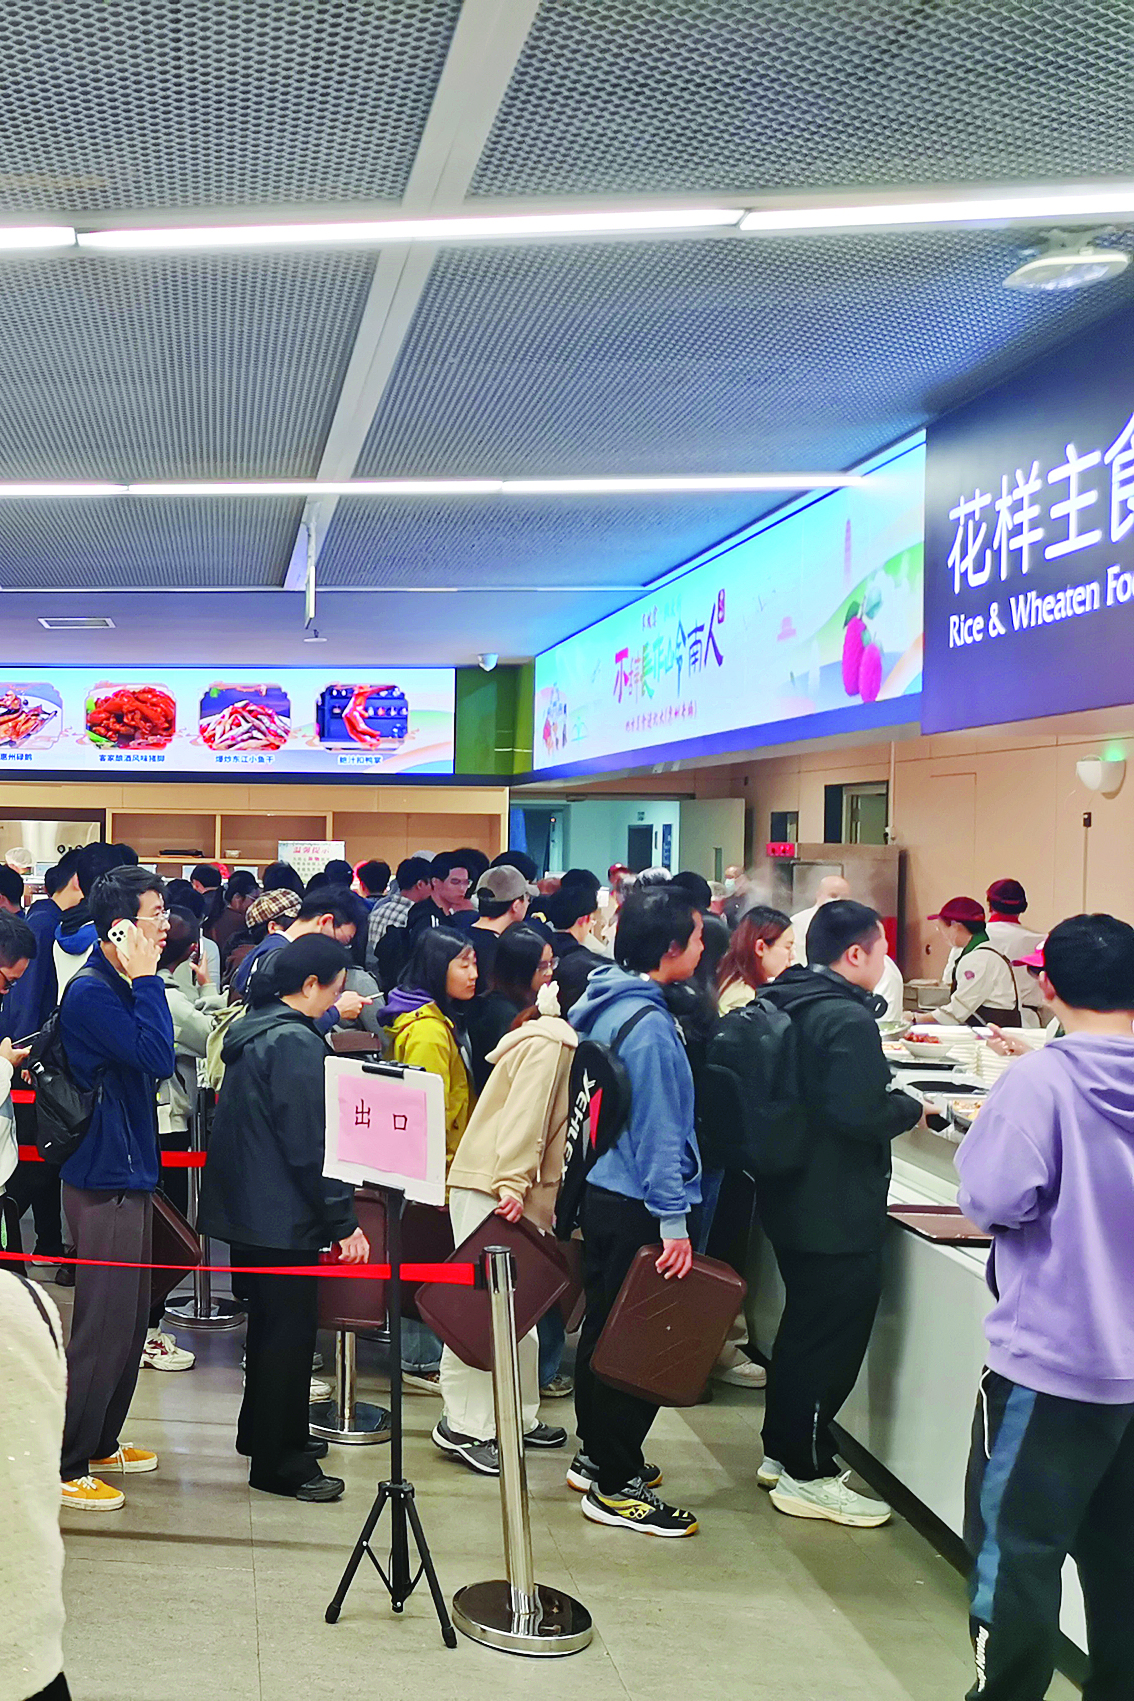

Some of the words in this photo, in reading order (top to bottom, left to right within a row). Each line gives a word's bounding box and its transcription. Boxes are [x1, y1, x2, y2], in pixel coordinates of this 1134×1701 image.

[948, 613, 984, 648] Rice
[988, 601, 1006, 638] &
[1009, 580, 1100, 631] Wheaten
[1106, 564, 1134, 607] Fo
[354, 1098, 408, 1131] 出口
